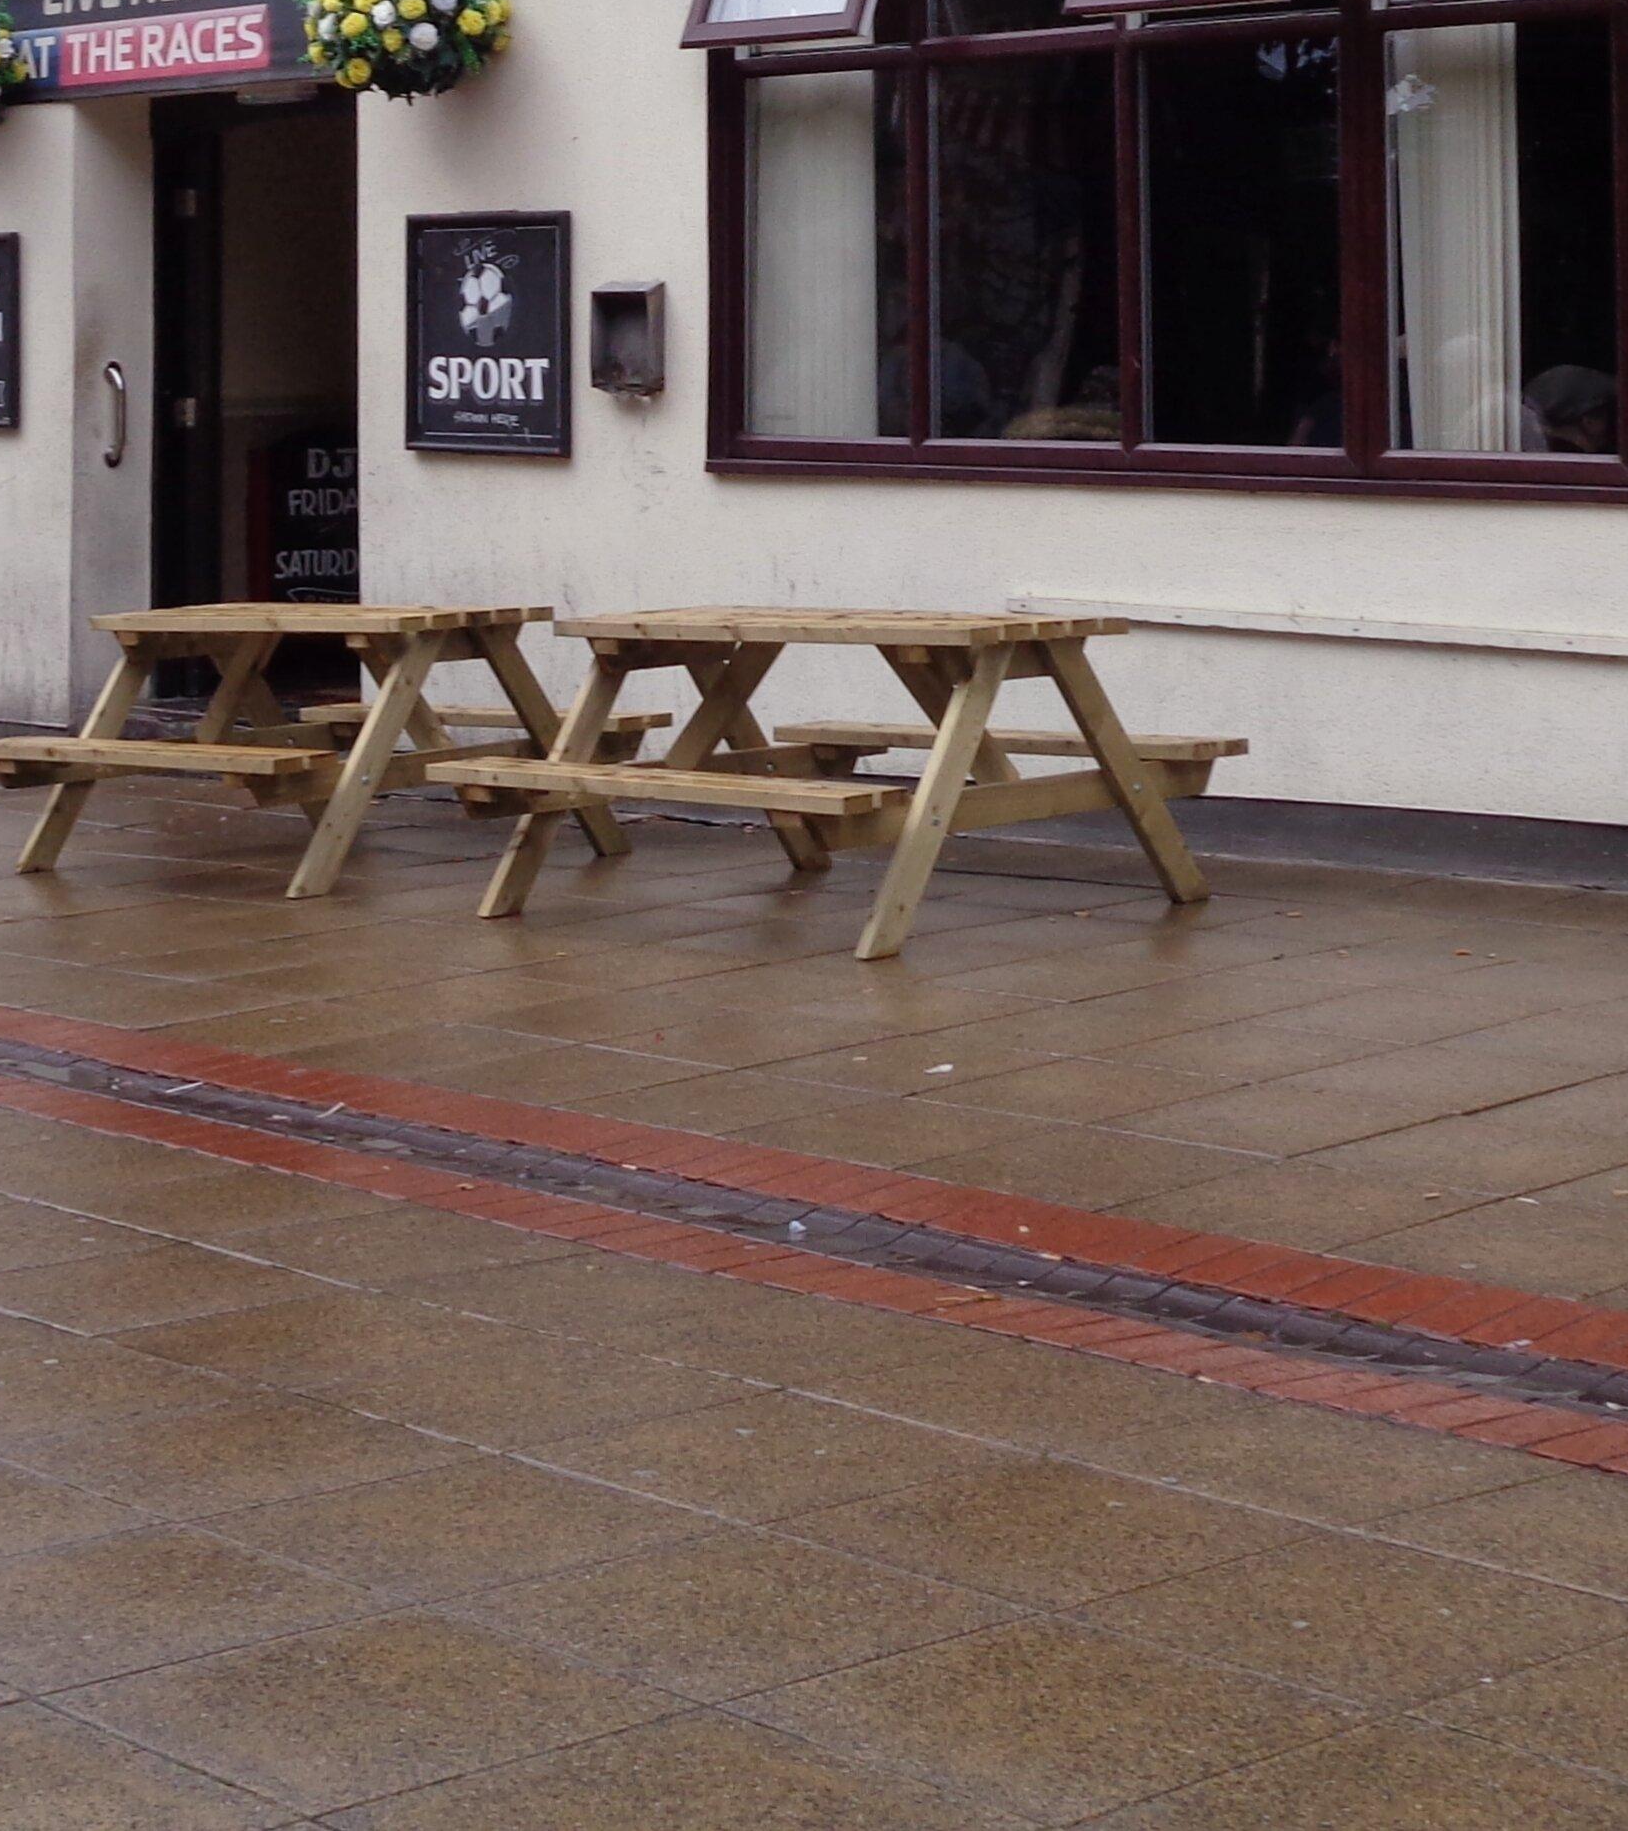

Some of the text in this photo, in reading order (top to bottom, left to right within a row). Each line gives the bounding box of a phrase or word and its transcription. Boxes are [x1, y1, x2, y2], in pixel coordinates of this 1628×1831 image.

[22, 13, 265, 79] AT THE RACES
[428, 356, 550, 401] SPORT
[288, 488, 358, 516] FRIDA
[274, 548, 357, 579] SATURD
